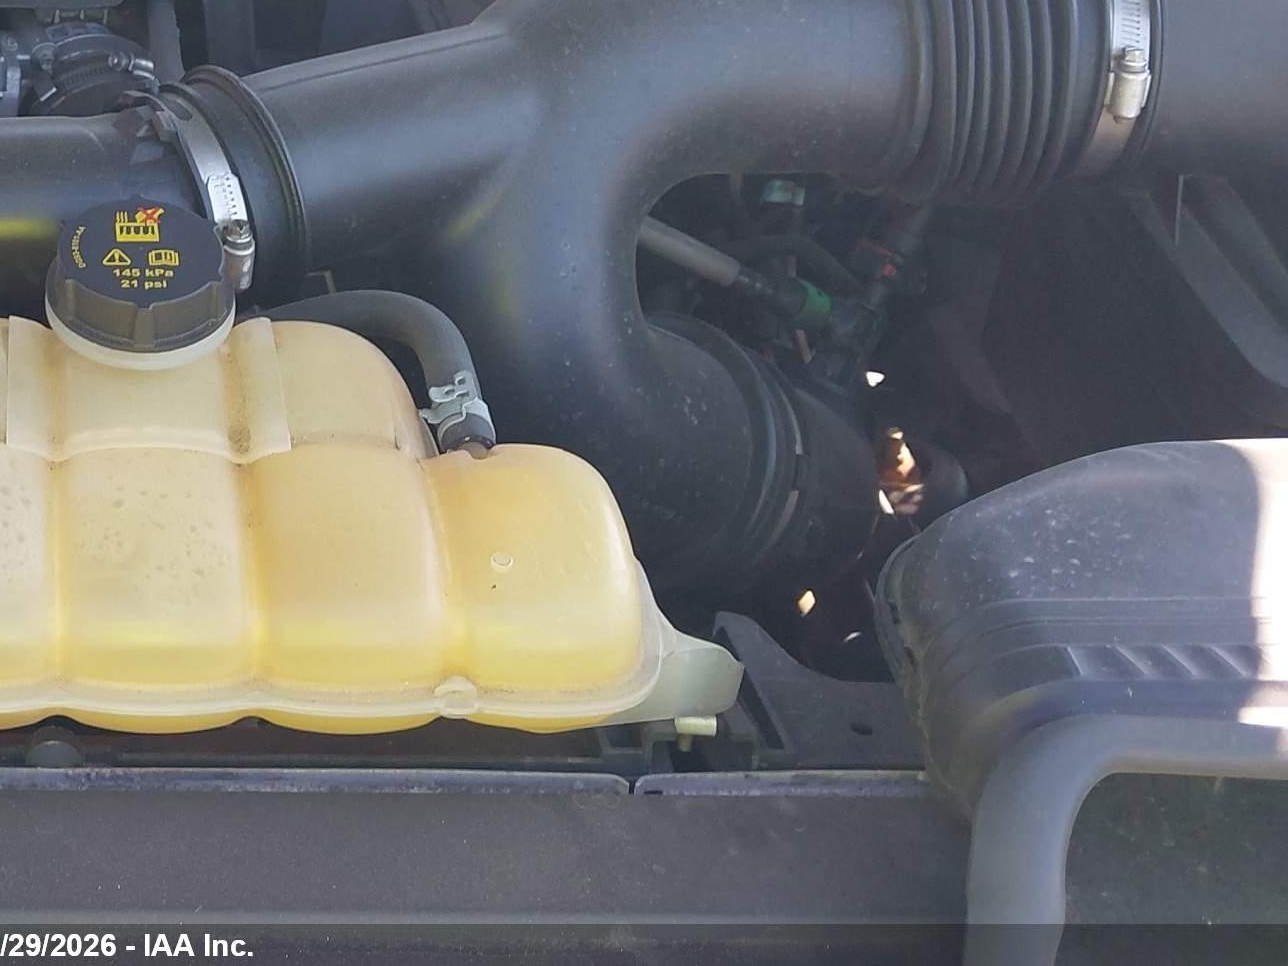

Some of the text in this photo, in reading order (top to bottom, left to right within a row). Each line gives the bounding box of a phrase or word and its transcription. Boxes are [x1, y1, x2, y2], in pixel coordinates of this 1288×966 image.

[112, 268, 174, 277] 145 kPa
[121, 279, 168, 290] 21 psi
